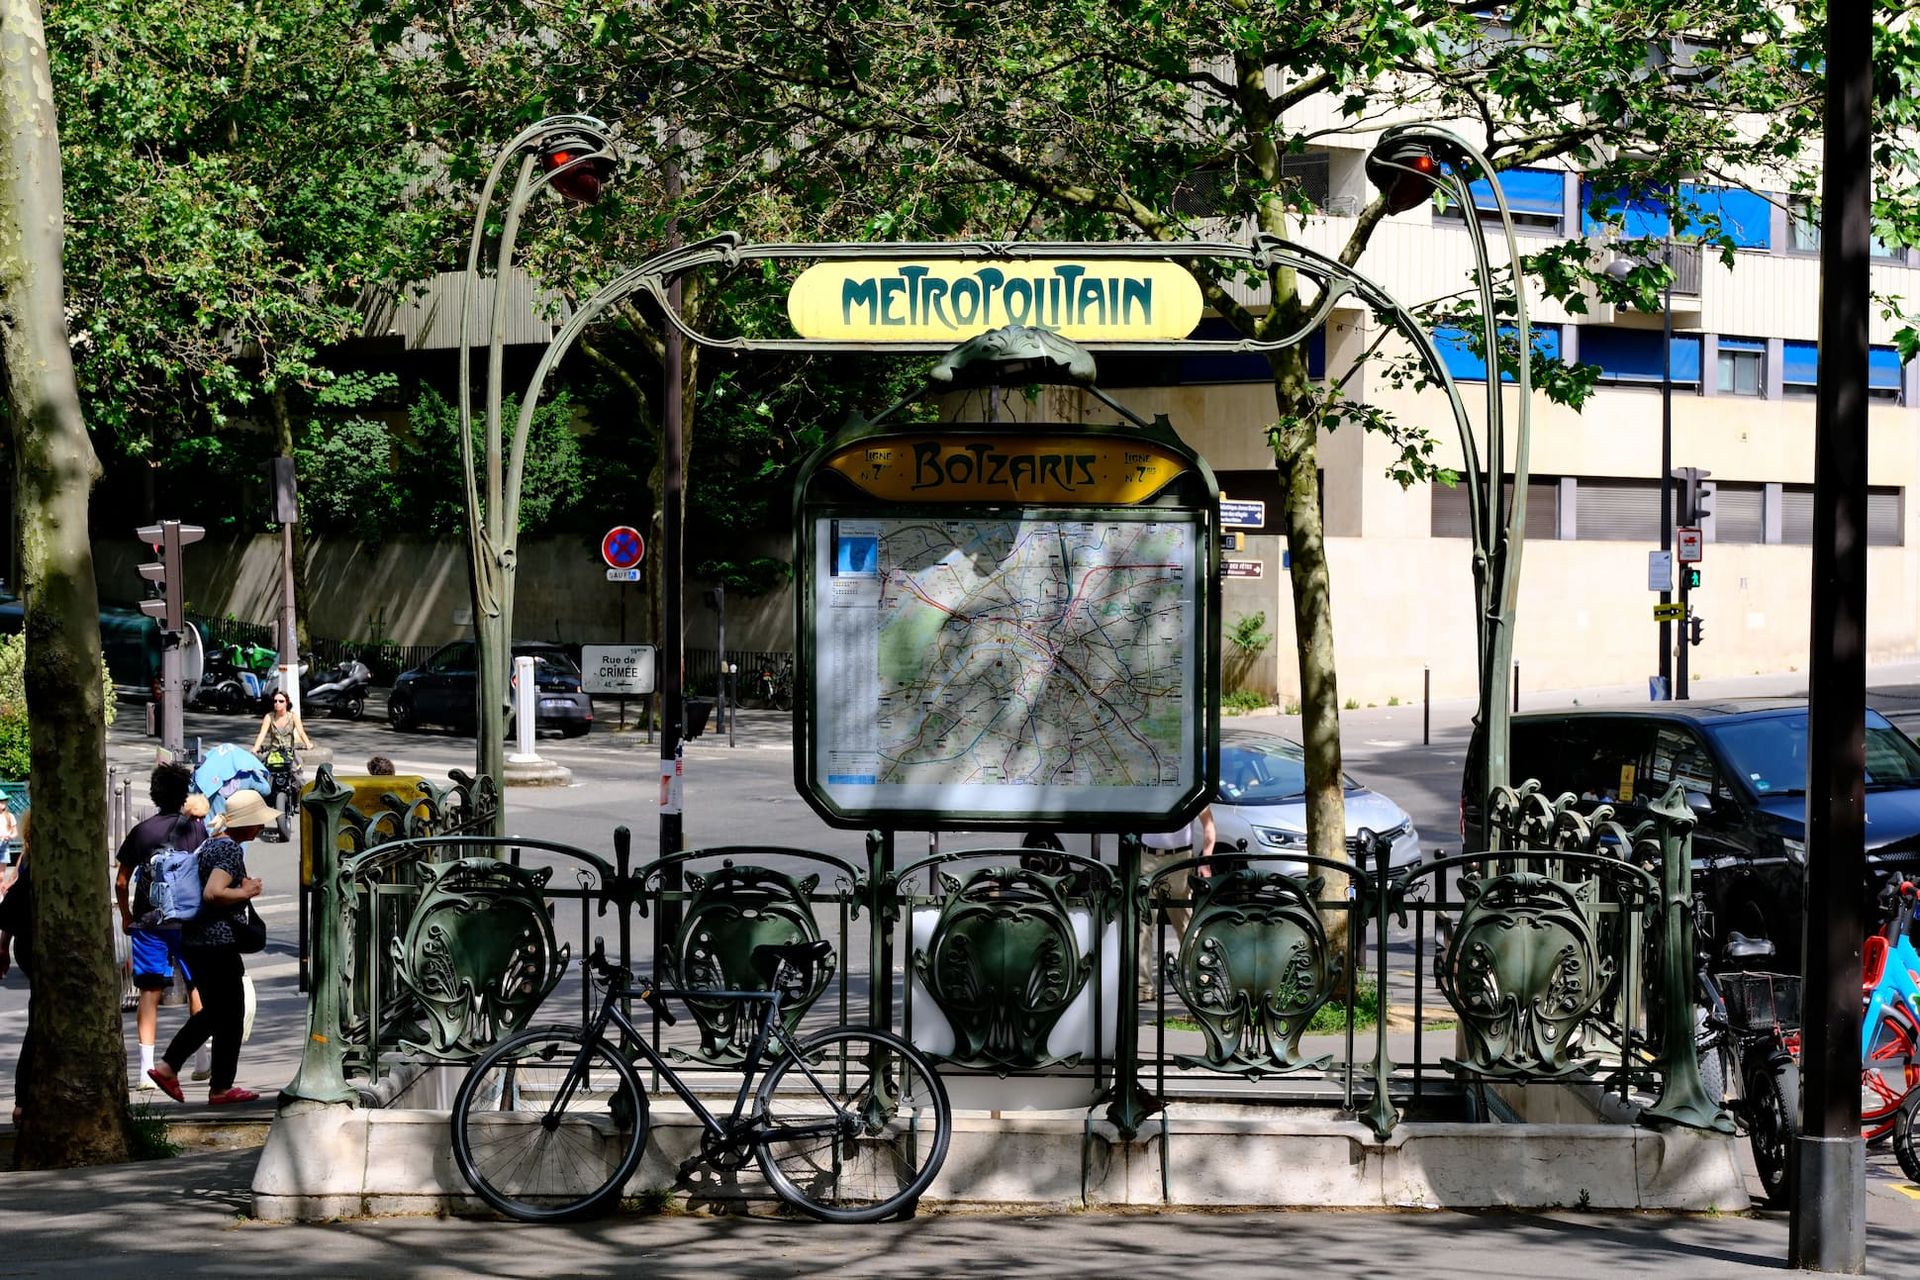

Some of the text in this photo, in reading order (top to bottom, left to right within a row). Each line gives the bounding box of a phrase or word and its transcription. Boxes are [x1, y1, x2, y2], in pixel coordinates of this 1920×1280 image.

[841, 264, 1152, 332] METROPOLITAIN
[912, 441, 1096, 491] BOTZARIS
[599, 665, 639, 678] CRIMÉE
[602, 656, 636, 664] Rue de
